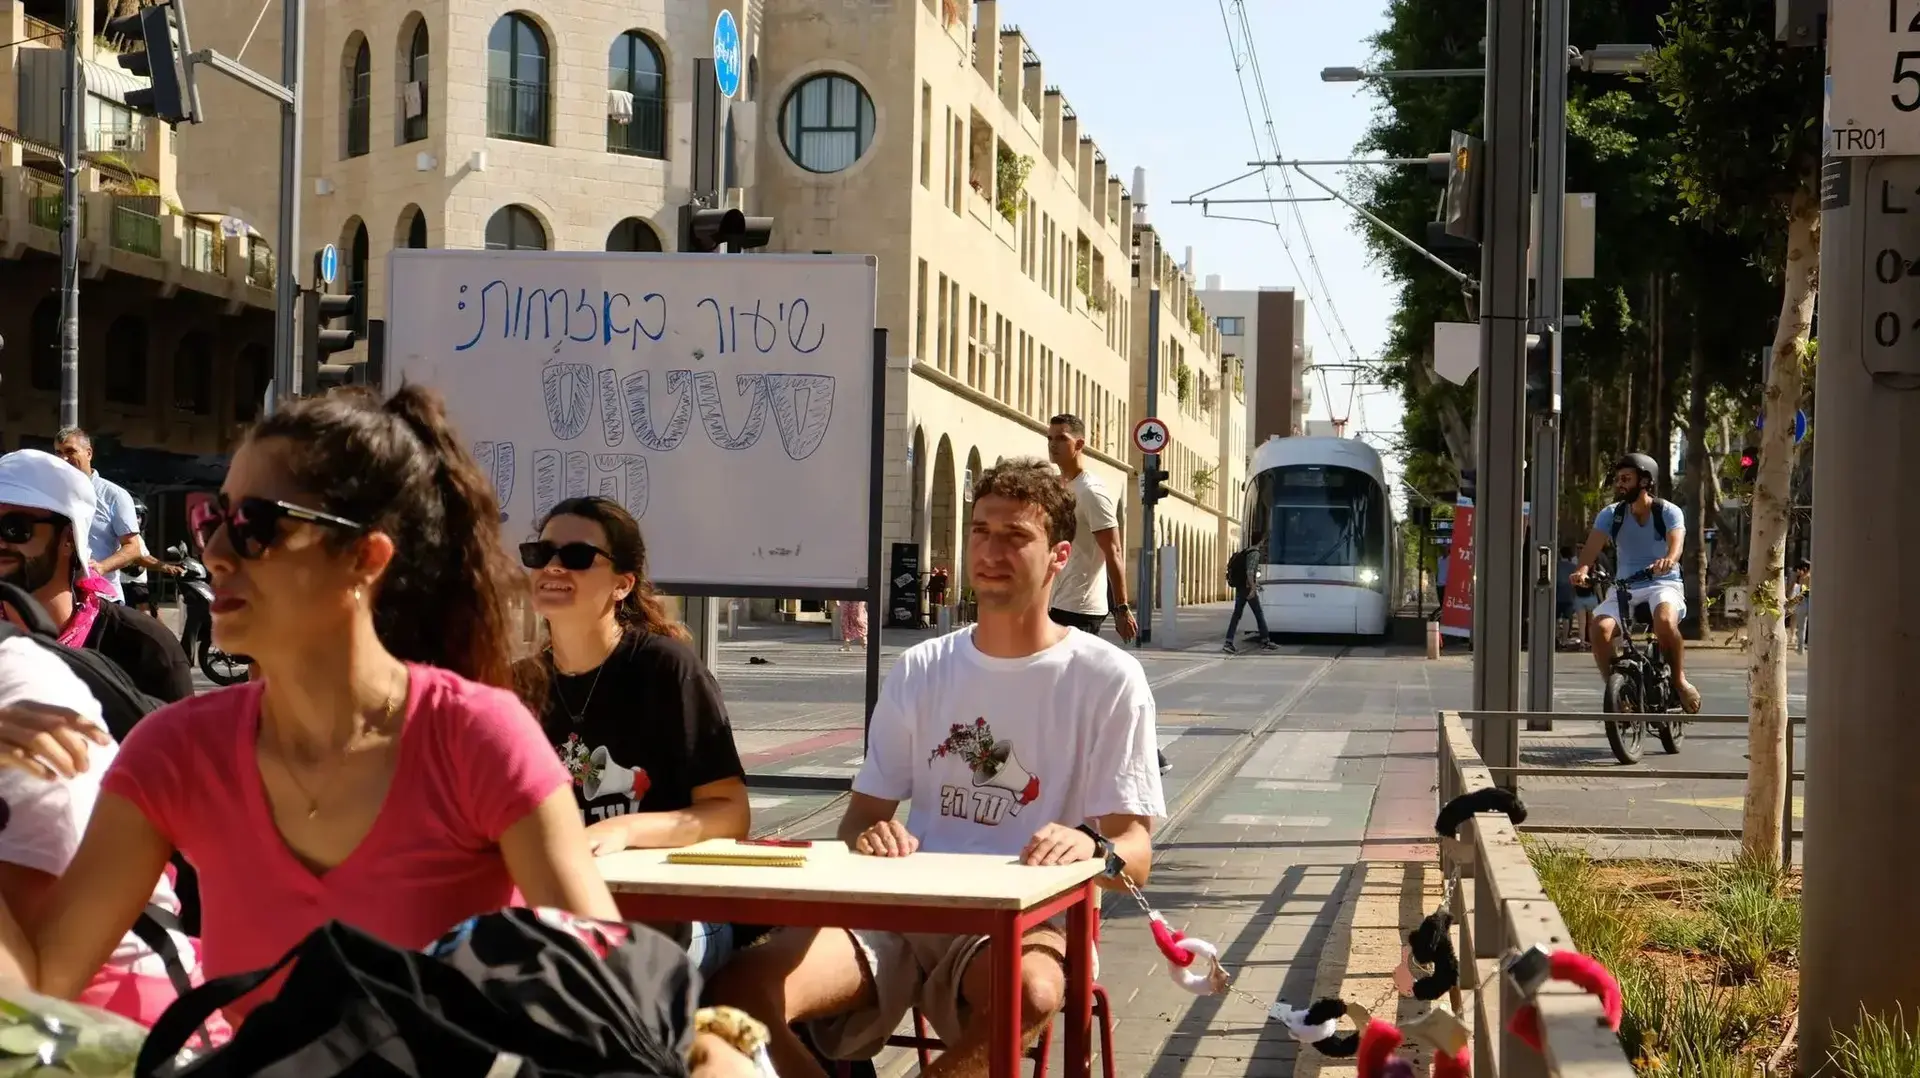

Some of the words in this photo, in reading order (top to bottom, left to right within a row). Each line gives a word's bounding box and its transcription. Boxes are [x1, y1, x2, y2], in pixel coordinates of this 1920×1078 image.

[1832, 128, 1886, 150] TR01
[1881, 180, 1920, 214] L
[697, 297, 825, 354] שיעור
[1874, 311, 1920, 347] 0
[541, 364, 836, 460] סטטוס
